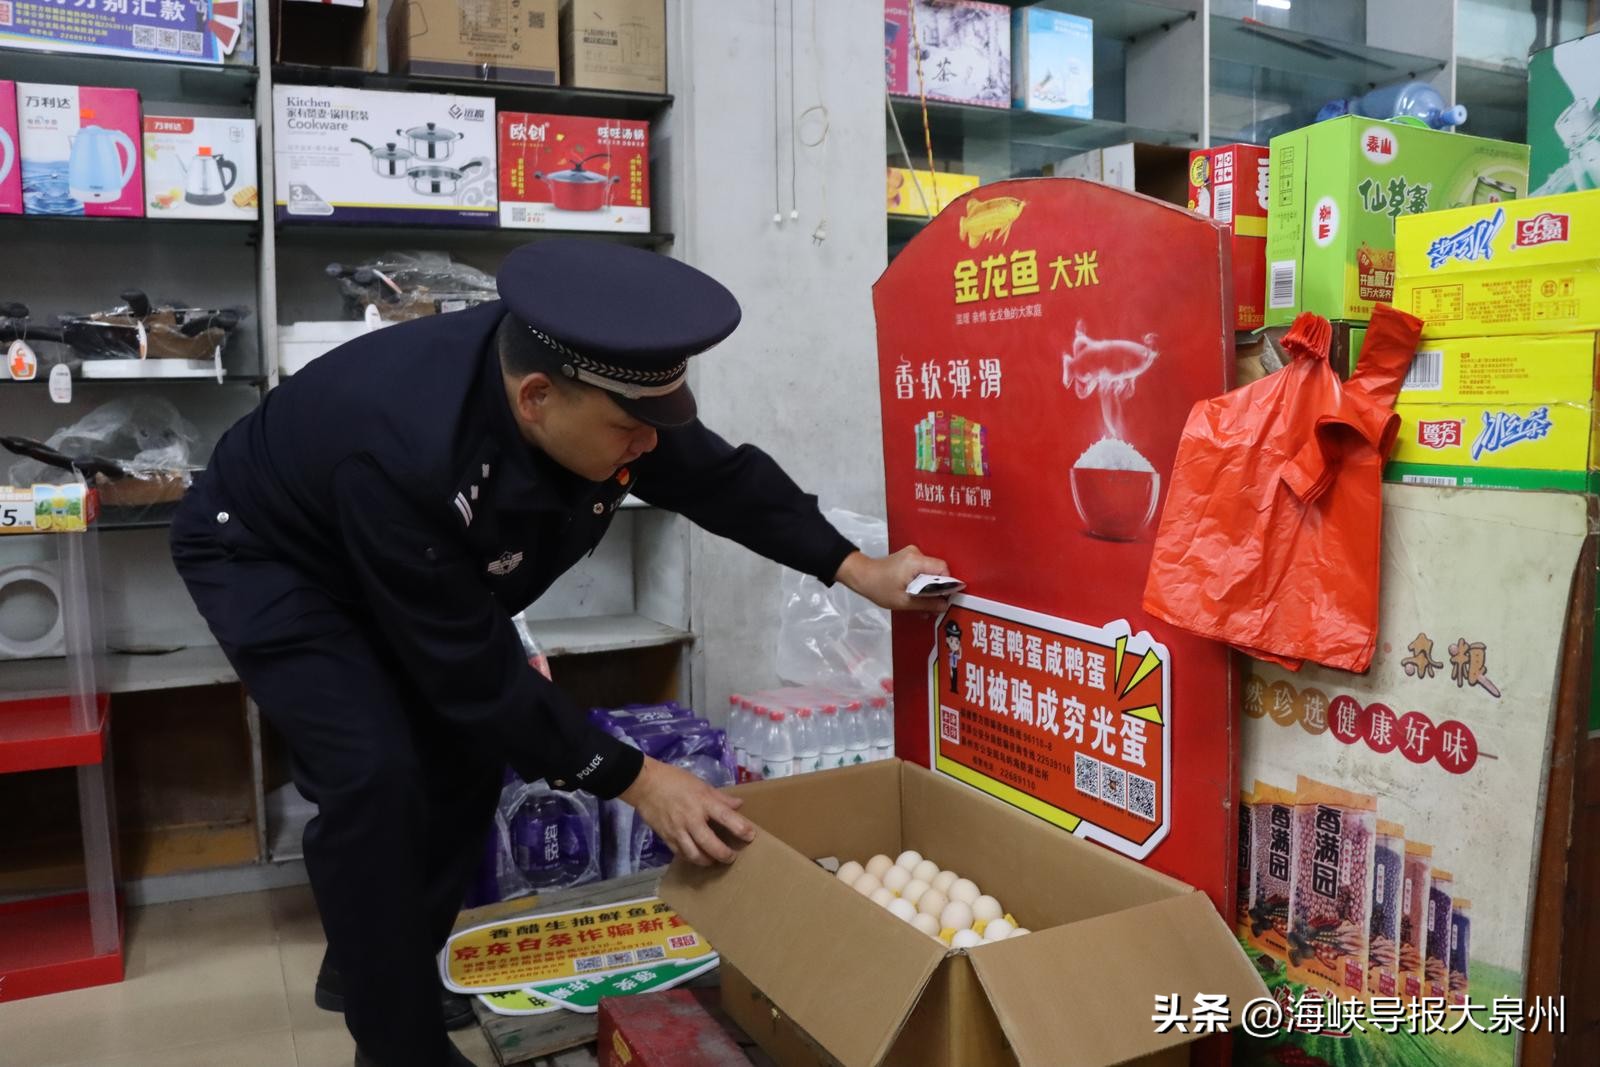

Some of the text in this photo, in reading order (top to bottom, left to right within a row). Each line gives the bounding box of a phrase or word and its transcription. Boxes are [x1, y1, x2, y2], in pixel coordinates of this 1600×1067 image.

[24, 96, 72, 110] 万利达
[286, 97, 331, 108] Kitchen
[287, 118, 349, 131] Cookware
[509, 123, 546, 142] 欧创
[1366, 135, 1393, 155] 泰山
[1358, 177, 1430, 222] 仙草蜜
[1427, 208, 1505, 269] 冰红茶
[954, 249, 1100, 304] 金龙鱼 大米
[989, 304, 1043, 322] 金龙鱼的大家庭
[1471, 406, 1553, 461] 冰红茶
[971, 620, 1107, 691] 鸡蛋鸭蛋咸鸭蛋
[964, 661, 1148, 768] 别被骗成穷光蛋
[576, 753, 604, 781] POLICE
[543, 823, 560, 862] 纯悦
[1268, 804, 1290, 882] 香满园
[1312, 804, 1342, 900] 香满园
